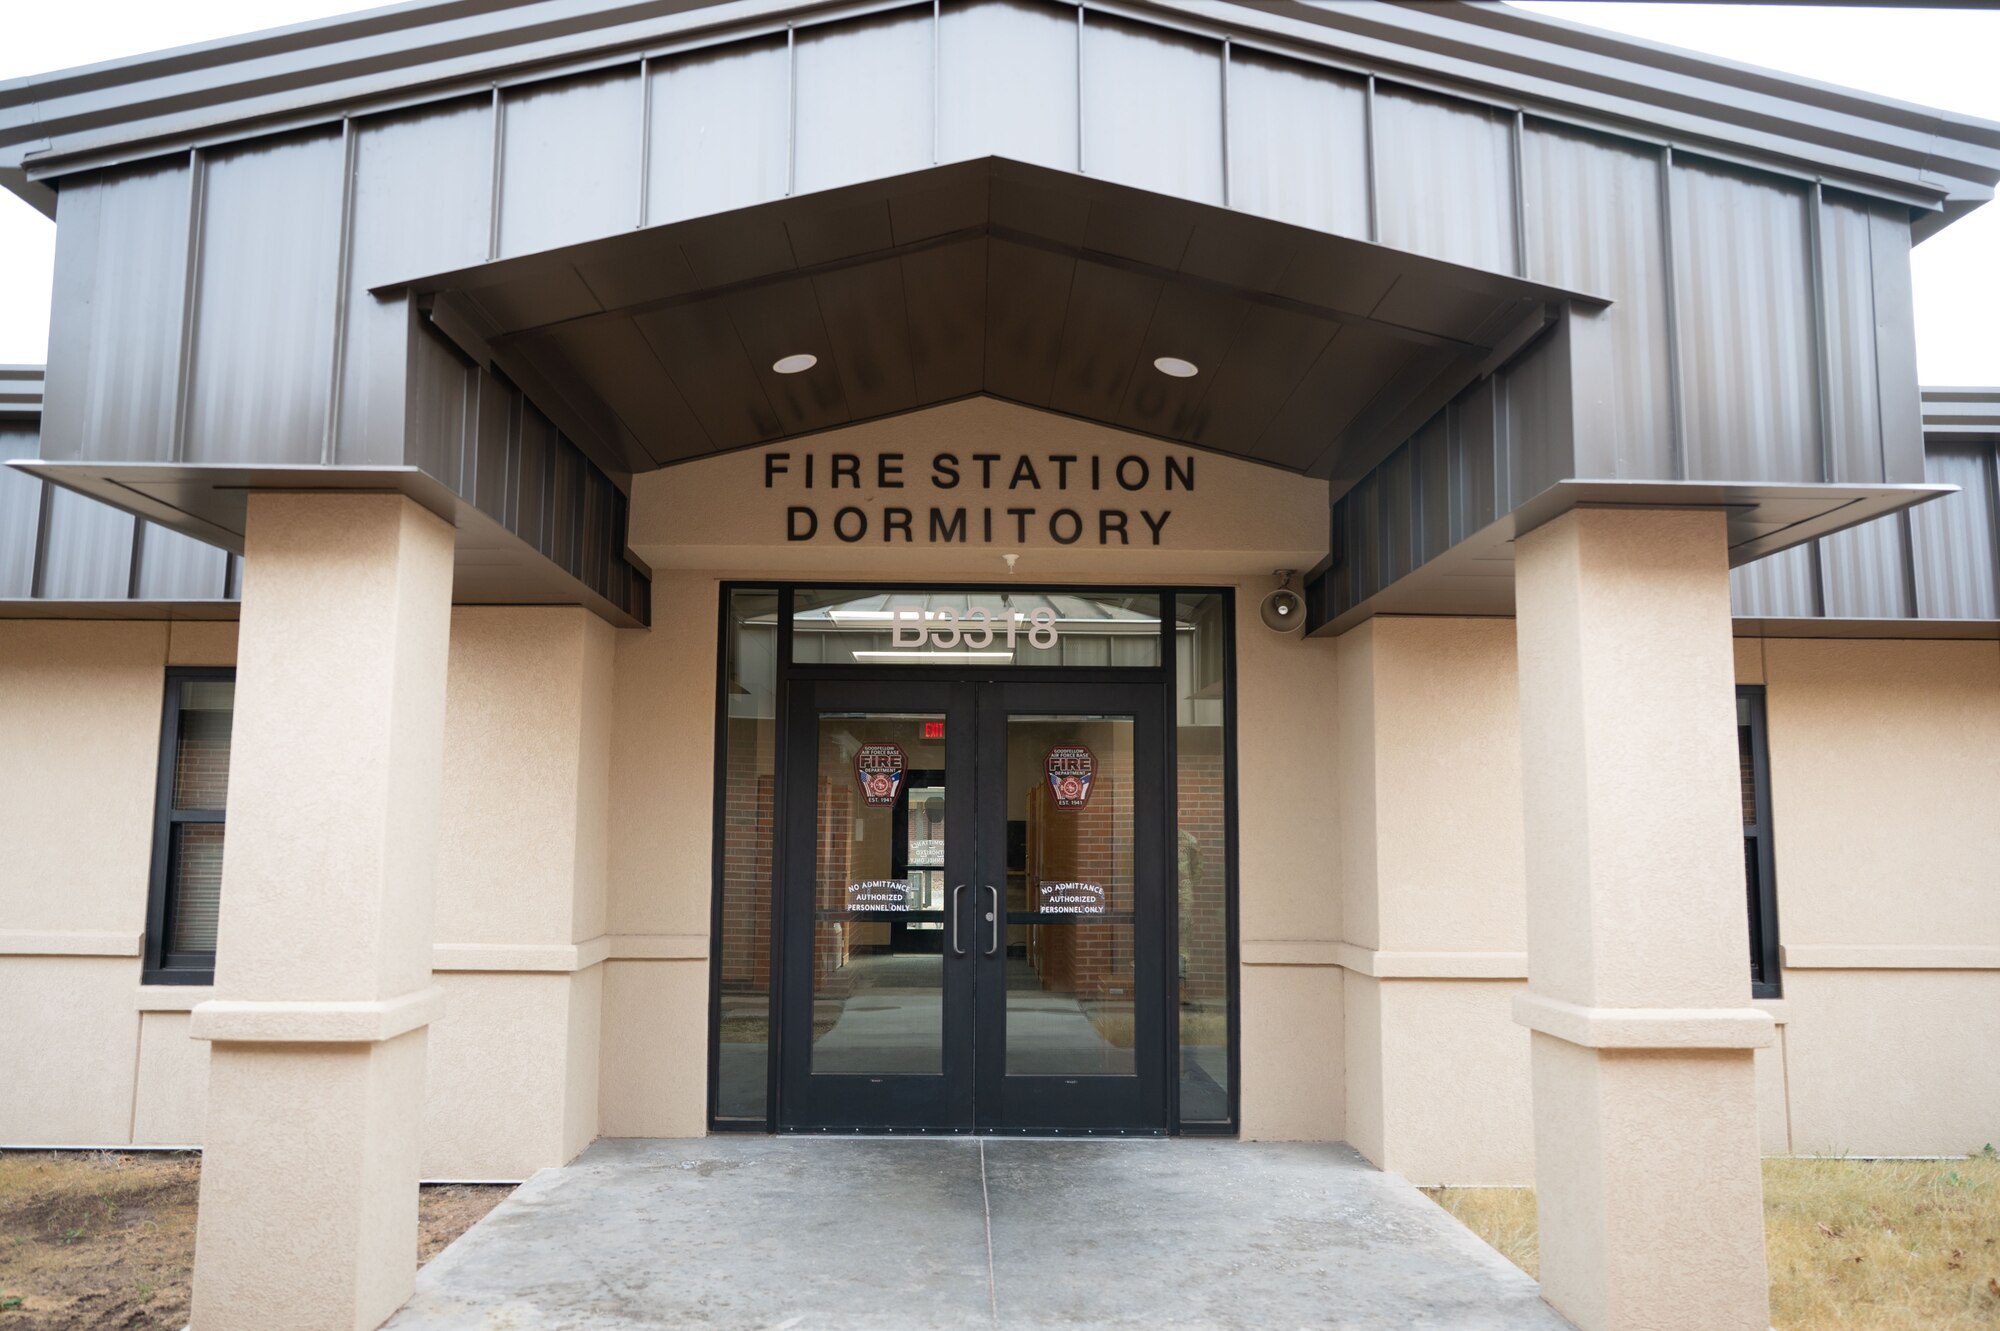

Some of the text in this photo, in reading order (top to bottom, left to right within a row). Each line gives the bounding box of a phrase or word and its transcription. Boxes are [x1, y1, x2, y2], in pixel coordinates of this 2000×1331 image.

[765, 453, 1195, 491] FIRE STATION
[787, 506, 1171, 545] DORMITORY
[892, 606, 1058, 649] B3318
[925, 721, 944, 737] EXIT
[859, 755, 902, 768] FIRE
[1049, 757, 1092, 771] FIRE
[848, 880, 911, 893] NO ADMITTANCE
[1041, 882, 1104, 895] NO ADMITTANCE
